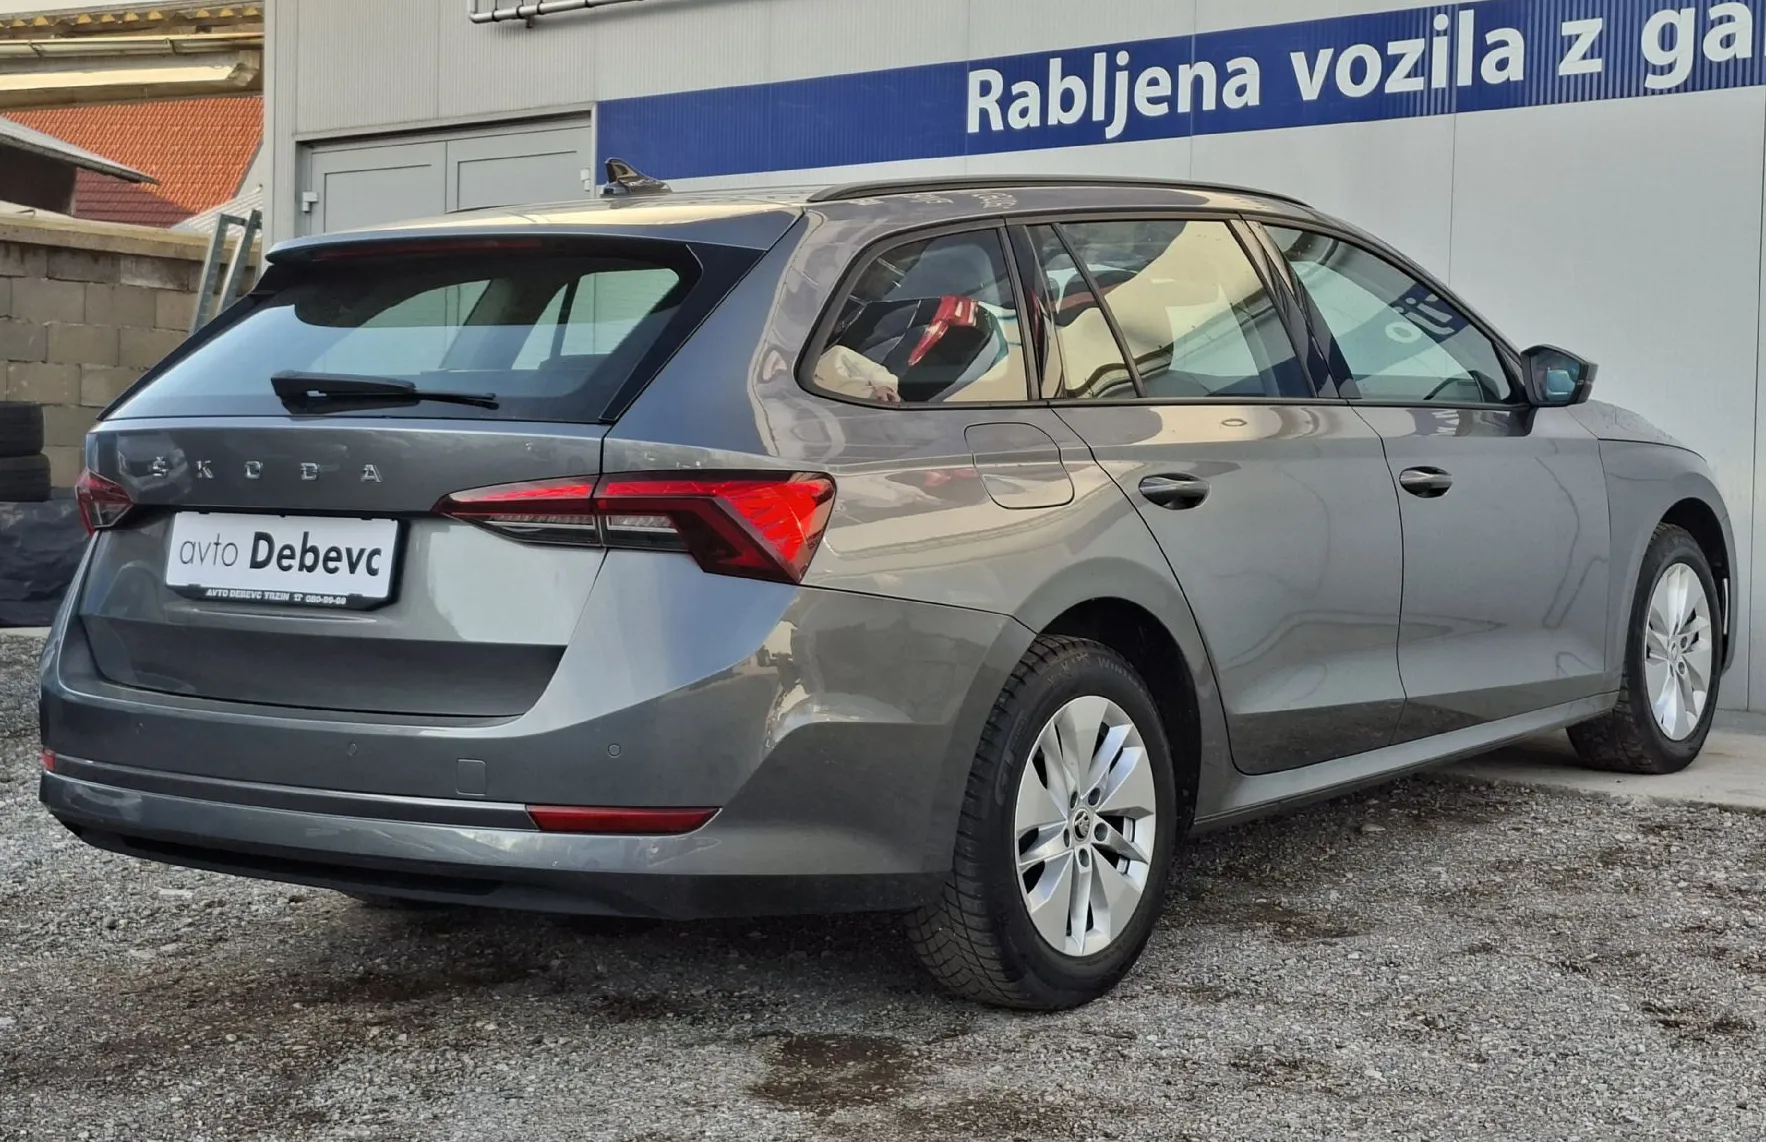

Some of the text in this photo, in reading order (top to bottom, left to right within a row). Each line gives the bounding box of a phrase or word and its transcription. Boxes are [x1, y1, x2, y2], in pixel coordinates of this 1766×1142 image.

[966, 49, 1261, 140] Rabljena
[1289, 9, 1525, 102] vozila
[1558, 16, 1603, 78] z
[179, 531, 382, 577] avto Debevc
